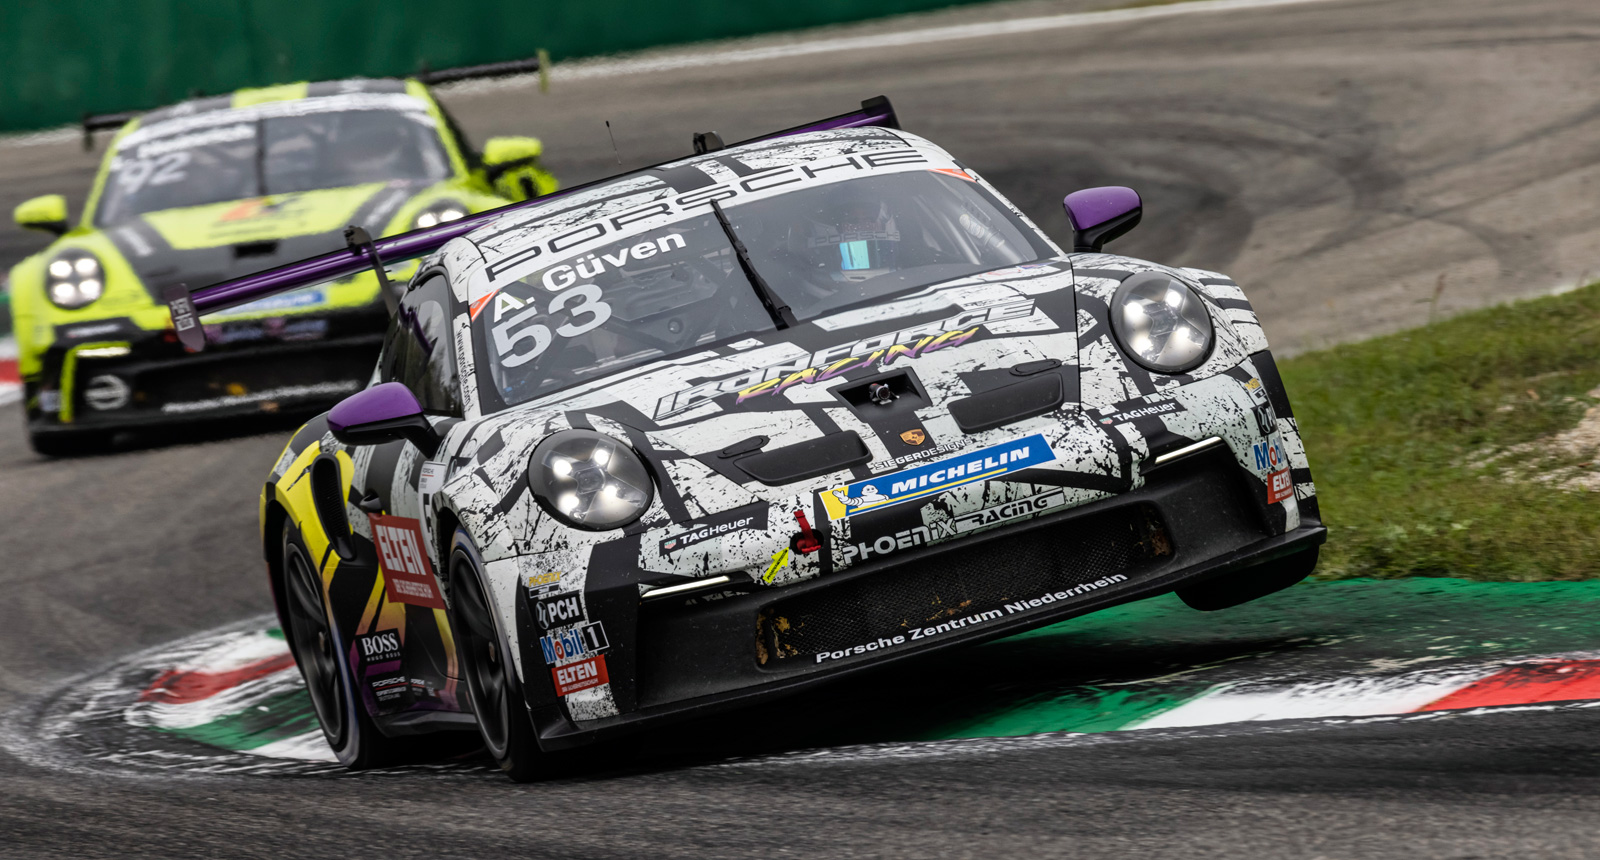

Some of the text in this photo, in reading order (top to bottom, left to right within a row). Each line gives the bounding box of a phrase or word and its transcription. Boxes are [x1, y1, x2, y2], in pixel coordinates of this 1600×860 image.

[117, 151, 190, 194] 92
[485, 150, 928, 282] PORSCHE
[494, 233, 687, 323] A. Güven
[492, 284, 612, 368] 53
[891, 446, 1030, 495] MICHELIN
[375, 524, 427, 576] ELTEN
[547, 597, 580, 623] PCH
[816, 573, 1128, 664] Porsche Zentrum Niederrhein
[361, 633, 399, 656] BOSS
[540, 626, 600, 664] Mobil 1
[556, 660, 598, 686] ELTEN
